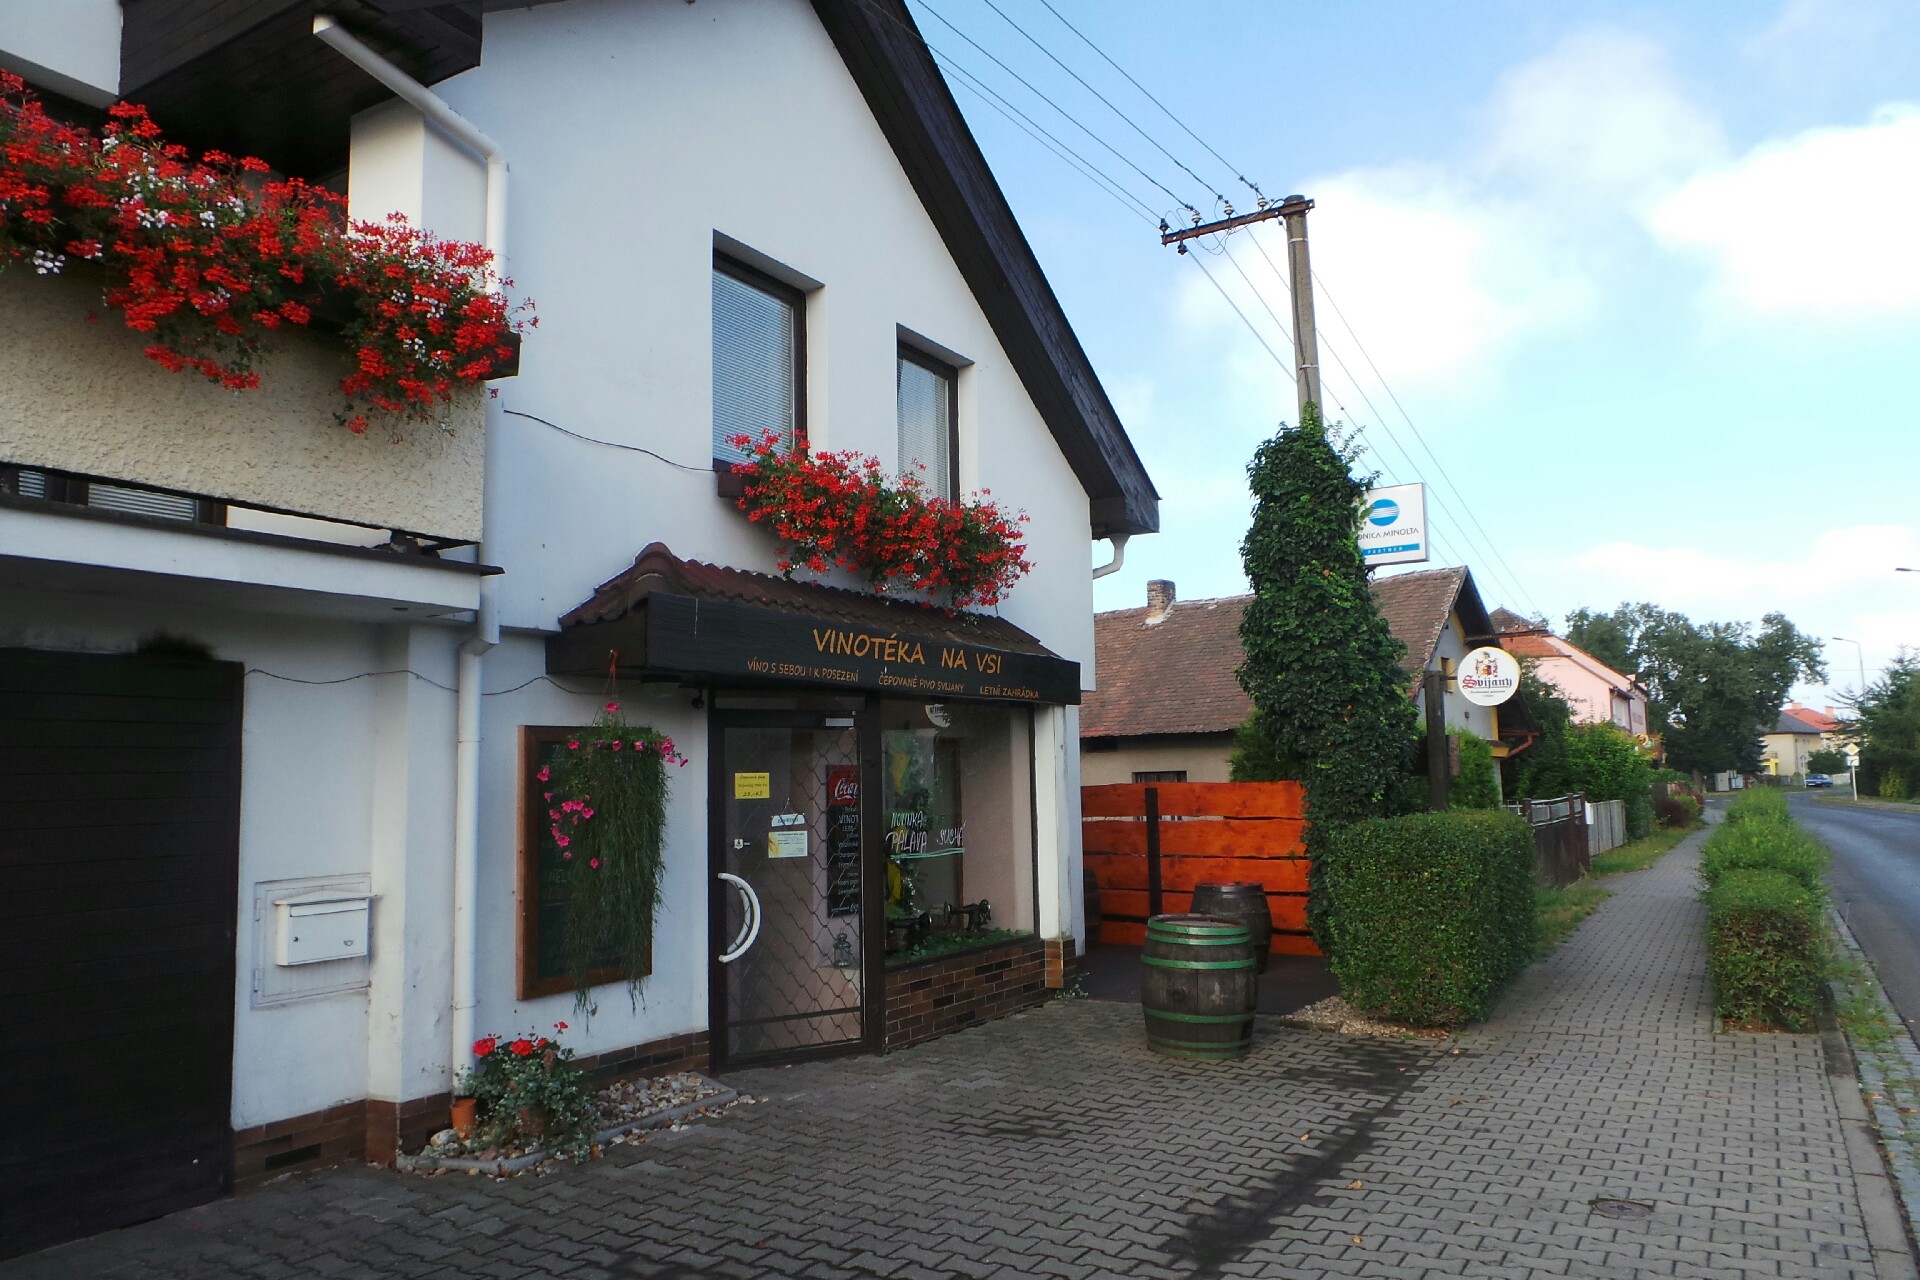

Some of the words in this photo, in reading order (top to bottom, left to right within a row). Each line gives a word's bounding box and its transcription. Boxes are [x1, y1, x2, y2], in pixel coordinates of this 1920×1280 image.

[1357, 532, 1381, 540] ONICA
[1383, 527, 1419, 538] MINOLTA
[813, 628, 925, 665] VINOTÉKA
[941, 647, 968, 671] NA
[976, 652, 1002, 674] VSI
[747, 656, 769, 673] VÍNO
[770, 662, 777, 674] S
[778, 663, 806, 677] SEBOU
[813, 667, 820, 678] K
[822, 668, 859, 682] POSEZENÍ
[878, 671, 918, 688] ČEPOVANÉ
[919, 678, 936, 690] PIVO
[937, 681, 965, 693] SVIJANY
[1462, 674, 1513, 689] Svijany
[979, 684, 1001, 696] LETNÍ
[1002, 686, 1040, 699] ZAHRÁDKA
